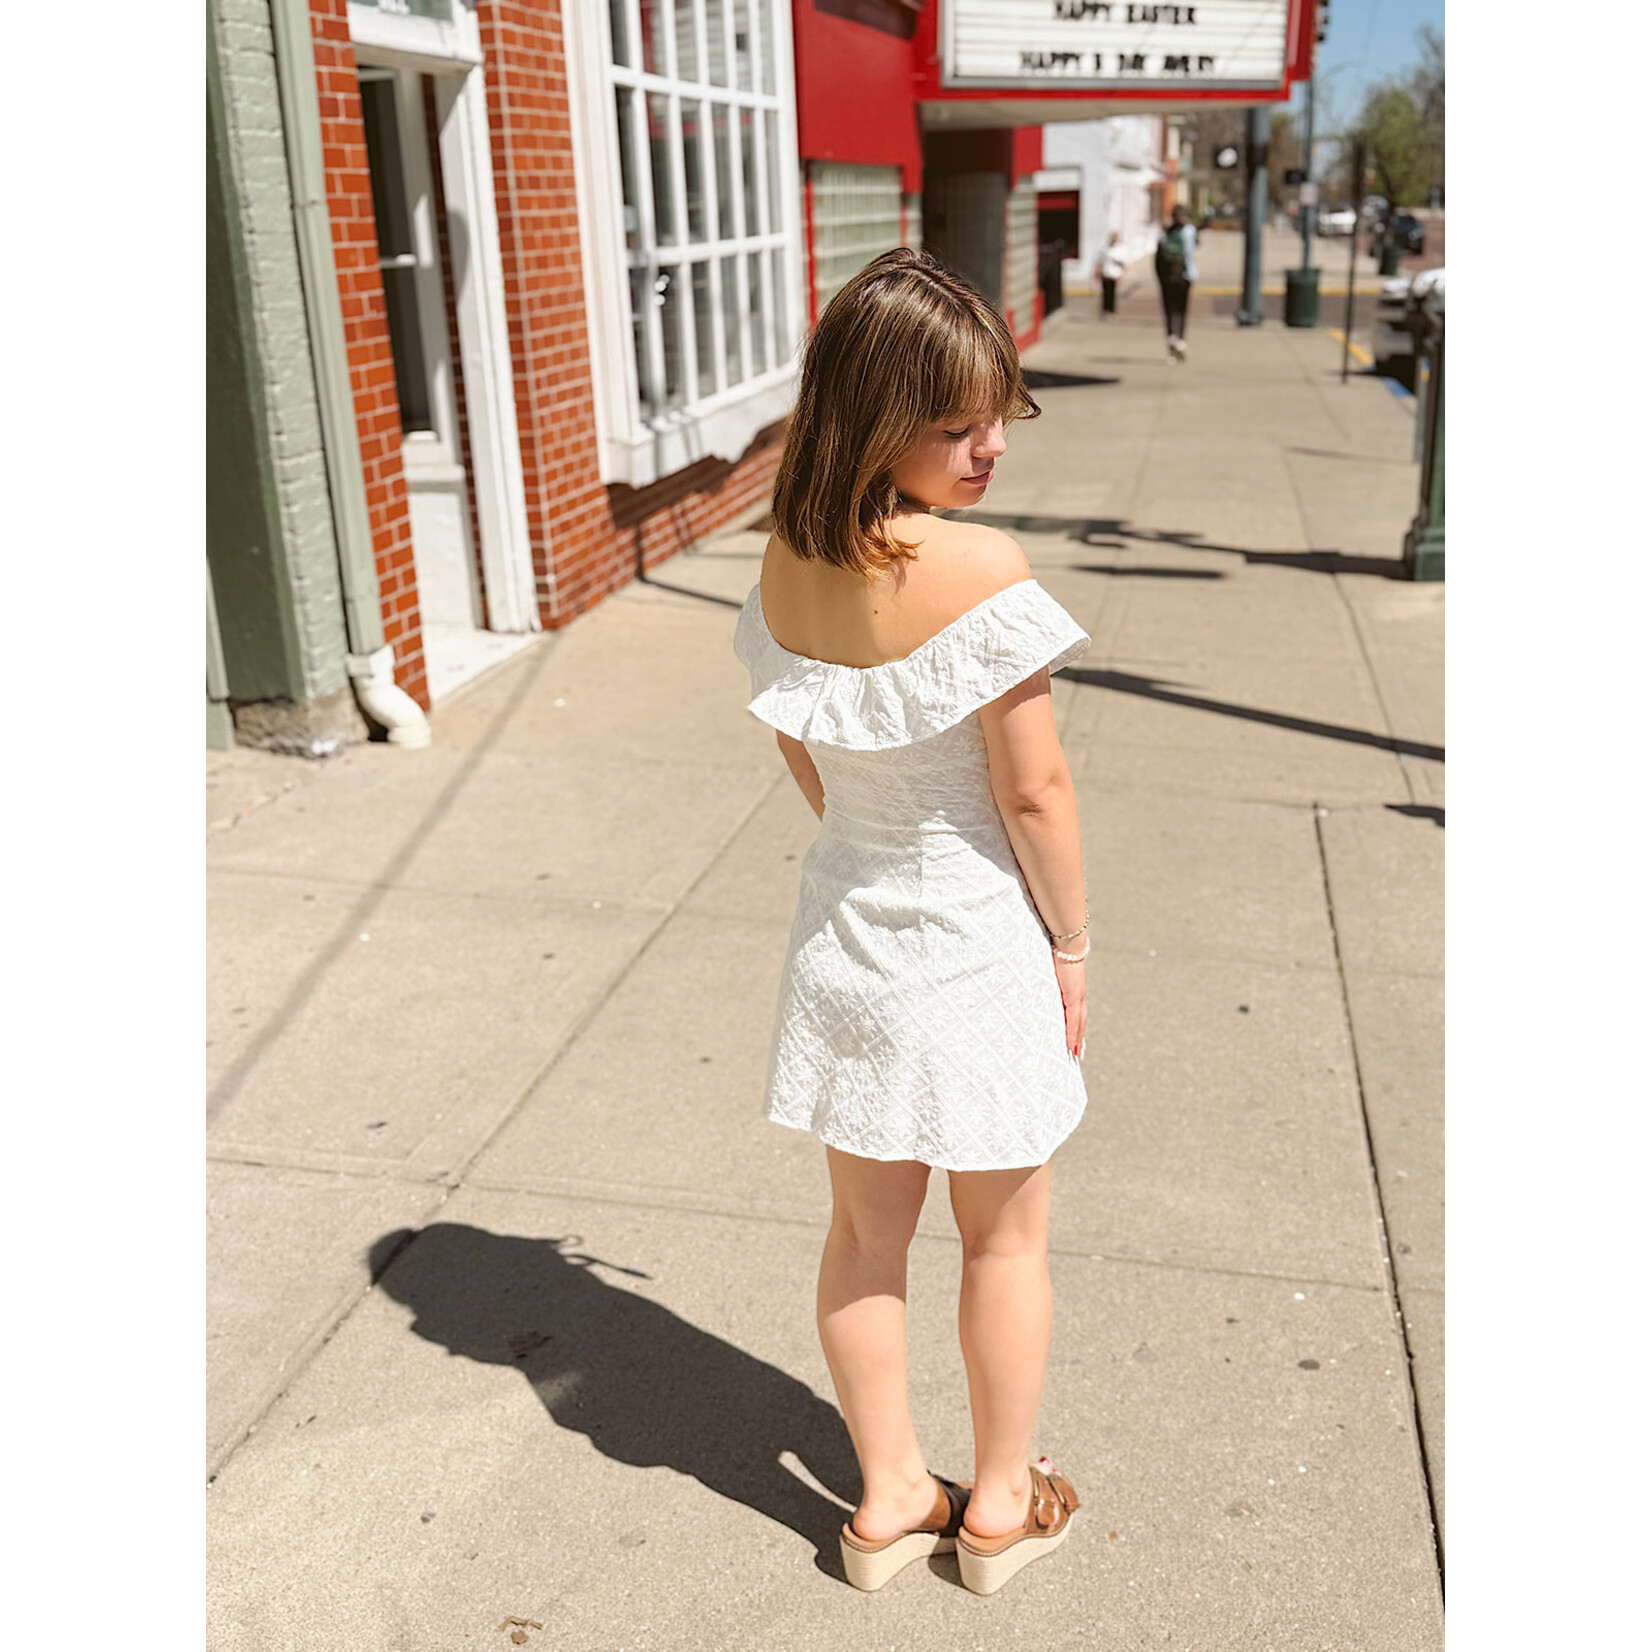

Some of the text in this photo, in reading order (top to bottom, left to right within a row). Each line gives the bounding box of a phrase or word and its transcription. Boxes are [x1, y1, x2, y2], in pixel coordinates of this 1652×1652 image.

[1053, 1, 1196, 24] HAPPY EASTER
[1019, 52, 1080, 72] HAPPY
